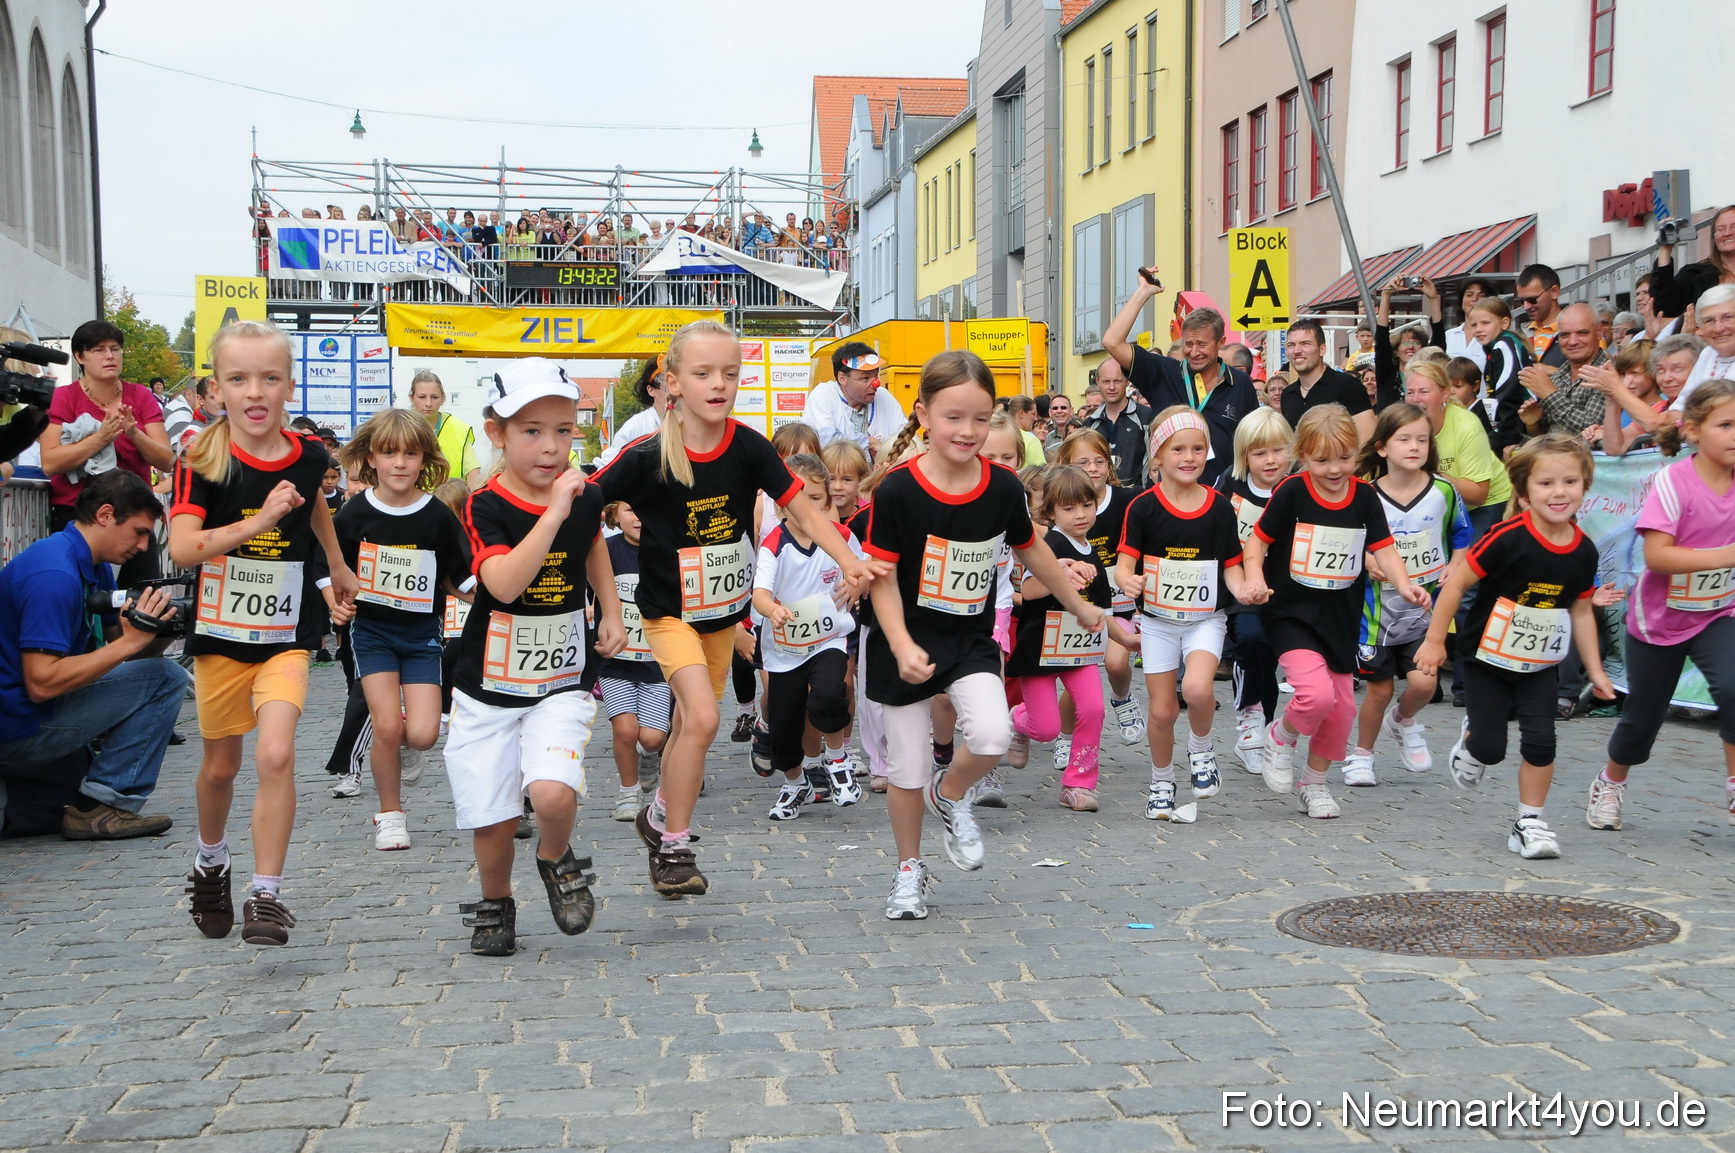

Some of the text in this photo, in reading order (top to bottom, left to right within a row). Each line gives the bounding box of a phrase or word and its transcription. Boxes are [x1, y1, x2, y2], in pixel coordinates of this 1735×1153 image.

[1237, 232, 1287, 250] Block
[559, 268, 617, 285] 13:43:22
[1244, 259, 1282, 308] A
[205, 279, 259, 299] Block
[404, 327, 478, 338] Neumarkter Stadtlauf
[521, 318, 595, 344] ZIEL
[637, 331, 674, 340] Neumarkte
[970, 331, 1025, 341] Schnupper-
[989, 343, 1007, 352] lauf
[310, 367, 336, 377] MCM
[687, 495, 730, 508] NEUMARKTER
[691, 502, 727, 513] STADTLAUF
[1395, 539, 1418, 550] Nora
[380, 551, 412, 567] Hanna
[706, 549, 741, 568] Sarah
[952, 547, 994, 563] Victoria
[1315, 551, 1357, 570] 7271
[230, 564, 274, 585] Louisa
[380, 570, 429, 592] 7168
[708, 562, 754, 597] 7083
[1160, 568, 1209, 581] Victoria
[527, 585, 574, 594] BAMBINILAUF
[1162, 583, 1210, 602] 7270
[230, 591, 293, 617] 7084
[787, 616, 834, 639] 7219
[1510, 611, 1567, 634] Katharina
[1063, 632, 1103, 649] 7224
[1511, 631, 1562, 654] 7314
[517, 645, 578, 671] 7262
